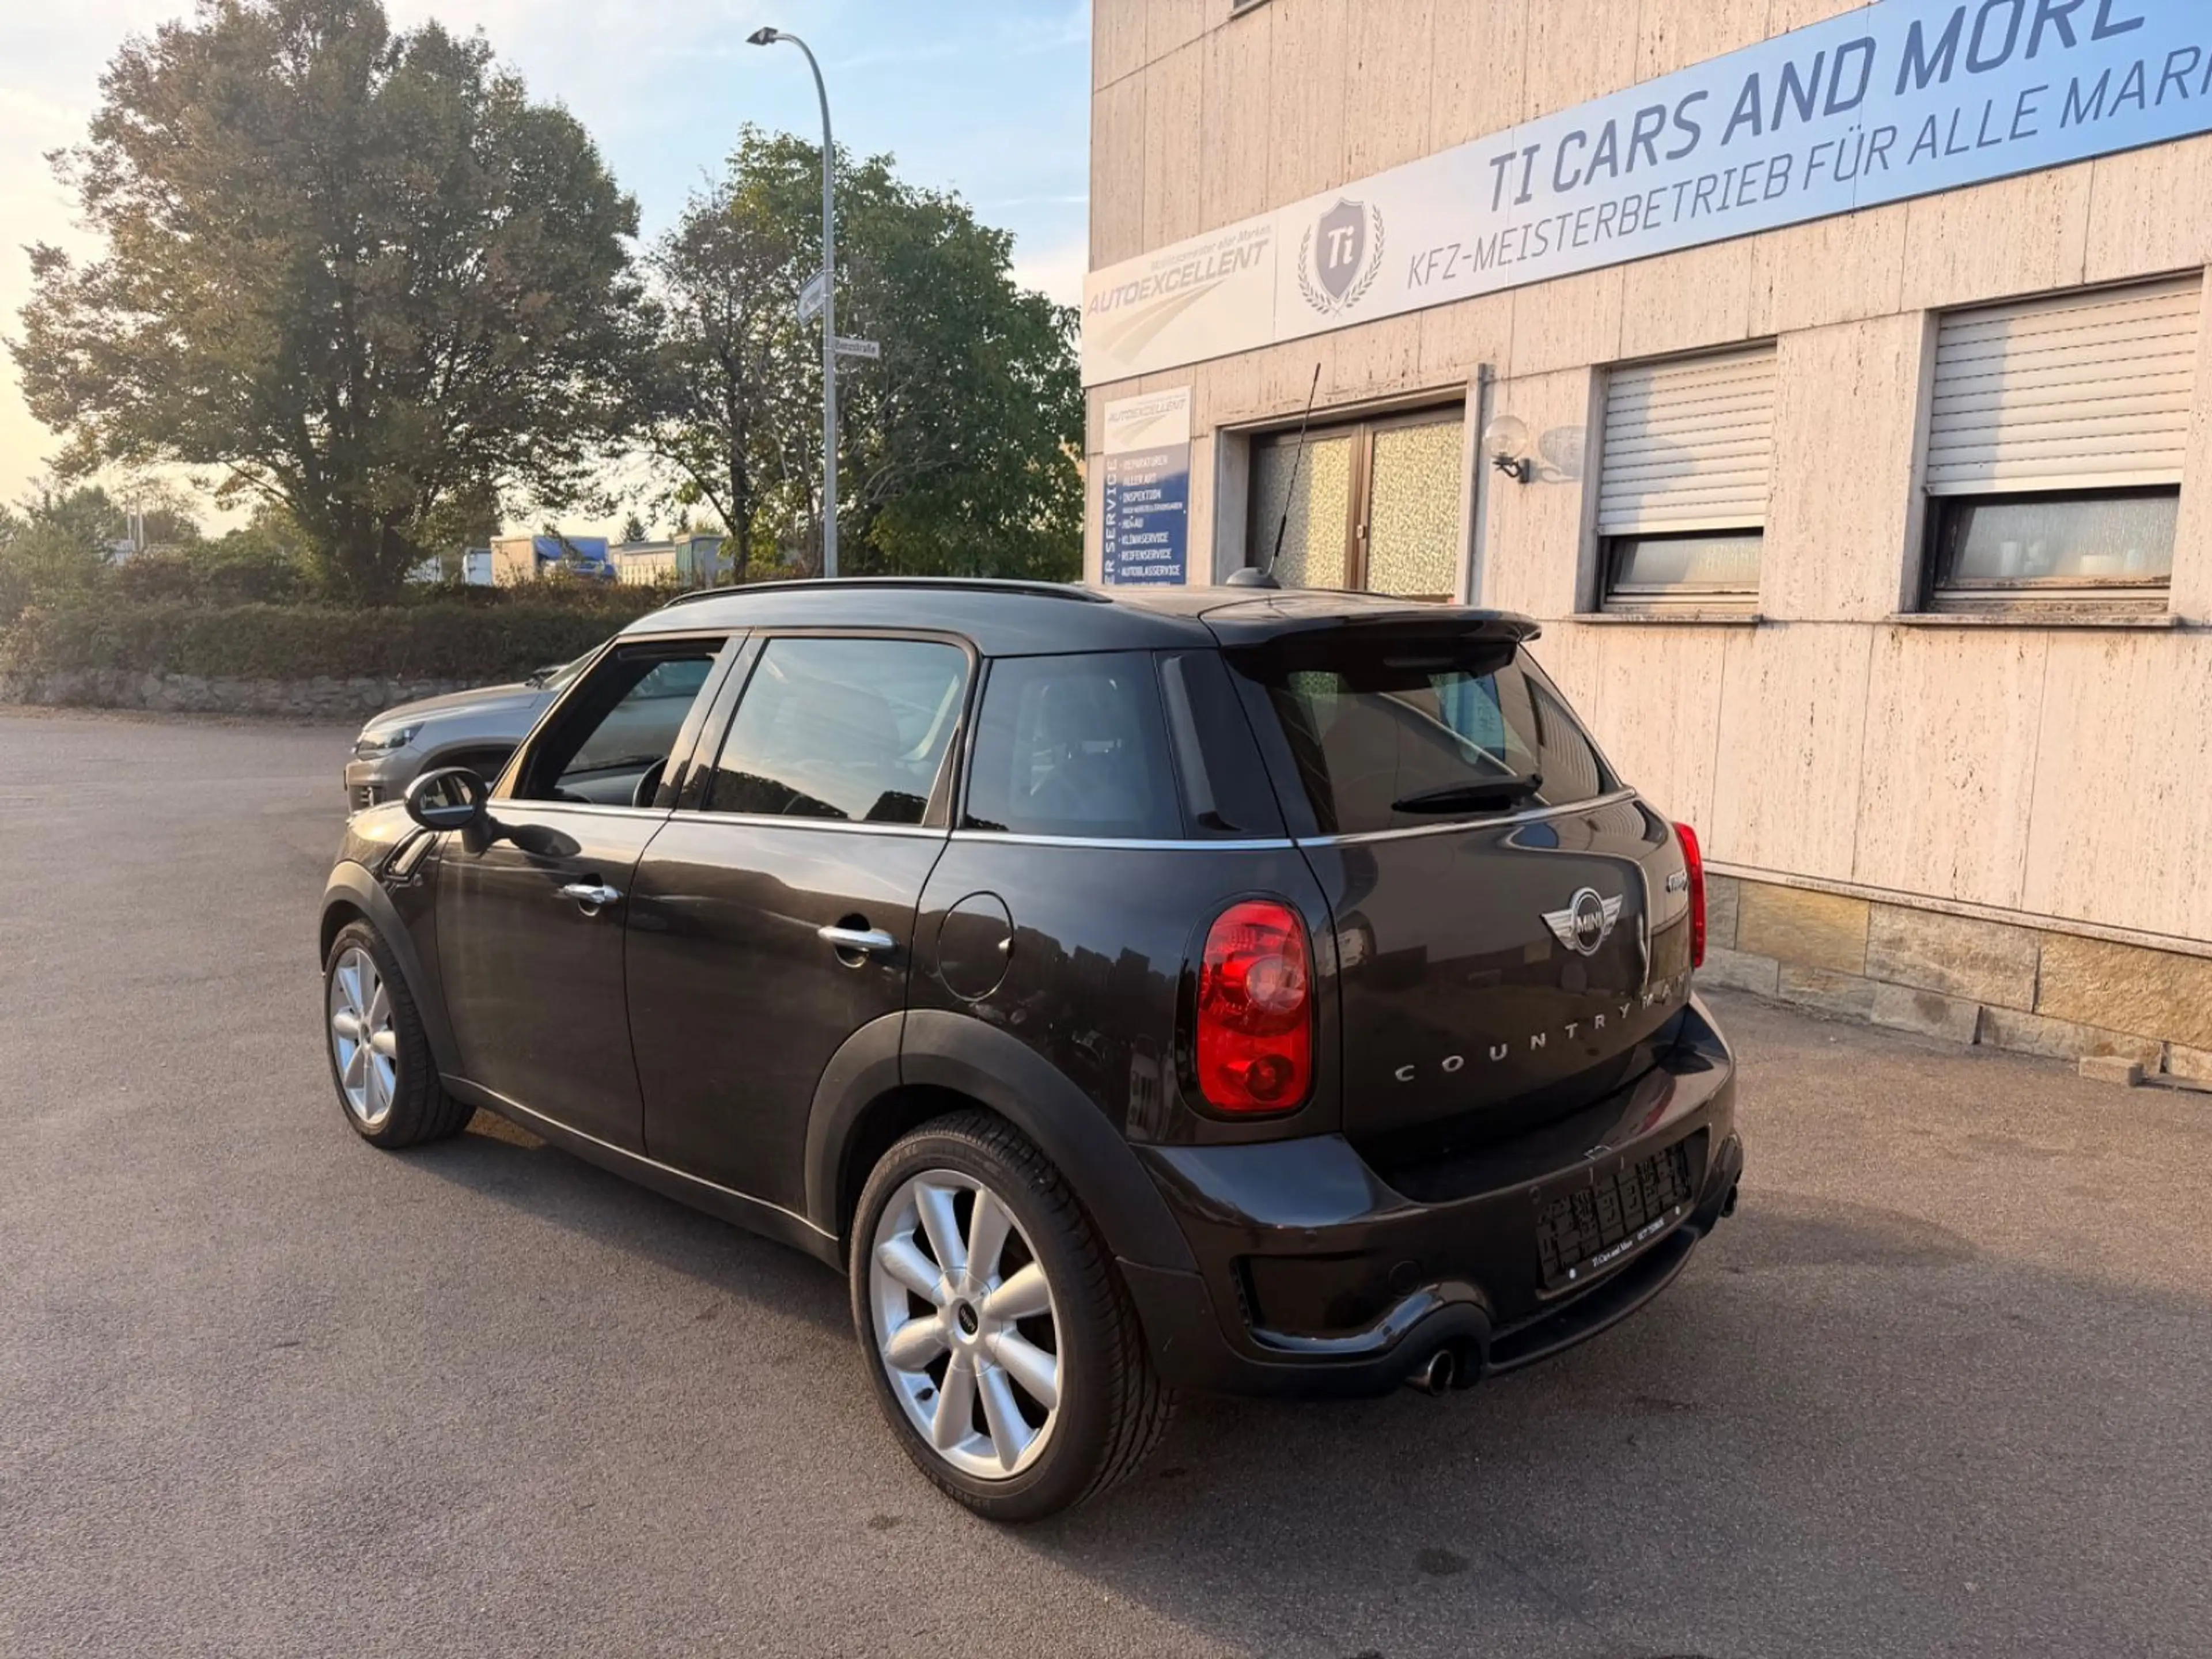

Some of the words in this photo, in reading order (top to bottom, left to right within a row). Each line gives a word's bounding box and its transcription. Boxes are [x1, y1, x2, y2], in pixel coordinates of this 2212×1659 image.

[1489, 143, 1540, 212] TI
[1552, 90, 1709, 194] CARS
[1720, 36, 1877, 146] AND
[1407, 153, 1793, 289] KFZ-MEISTERBETRIEB
[1802, 124, 1897, 191] FÜR
[1907, 85, 2050, 165] ALLE
[1086, 238, 1269, 317] AUTOEXCELLENT
[1327, 225, 1354, 270] Ti
[1105, 459, 1117, 553] SERVICE
